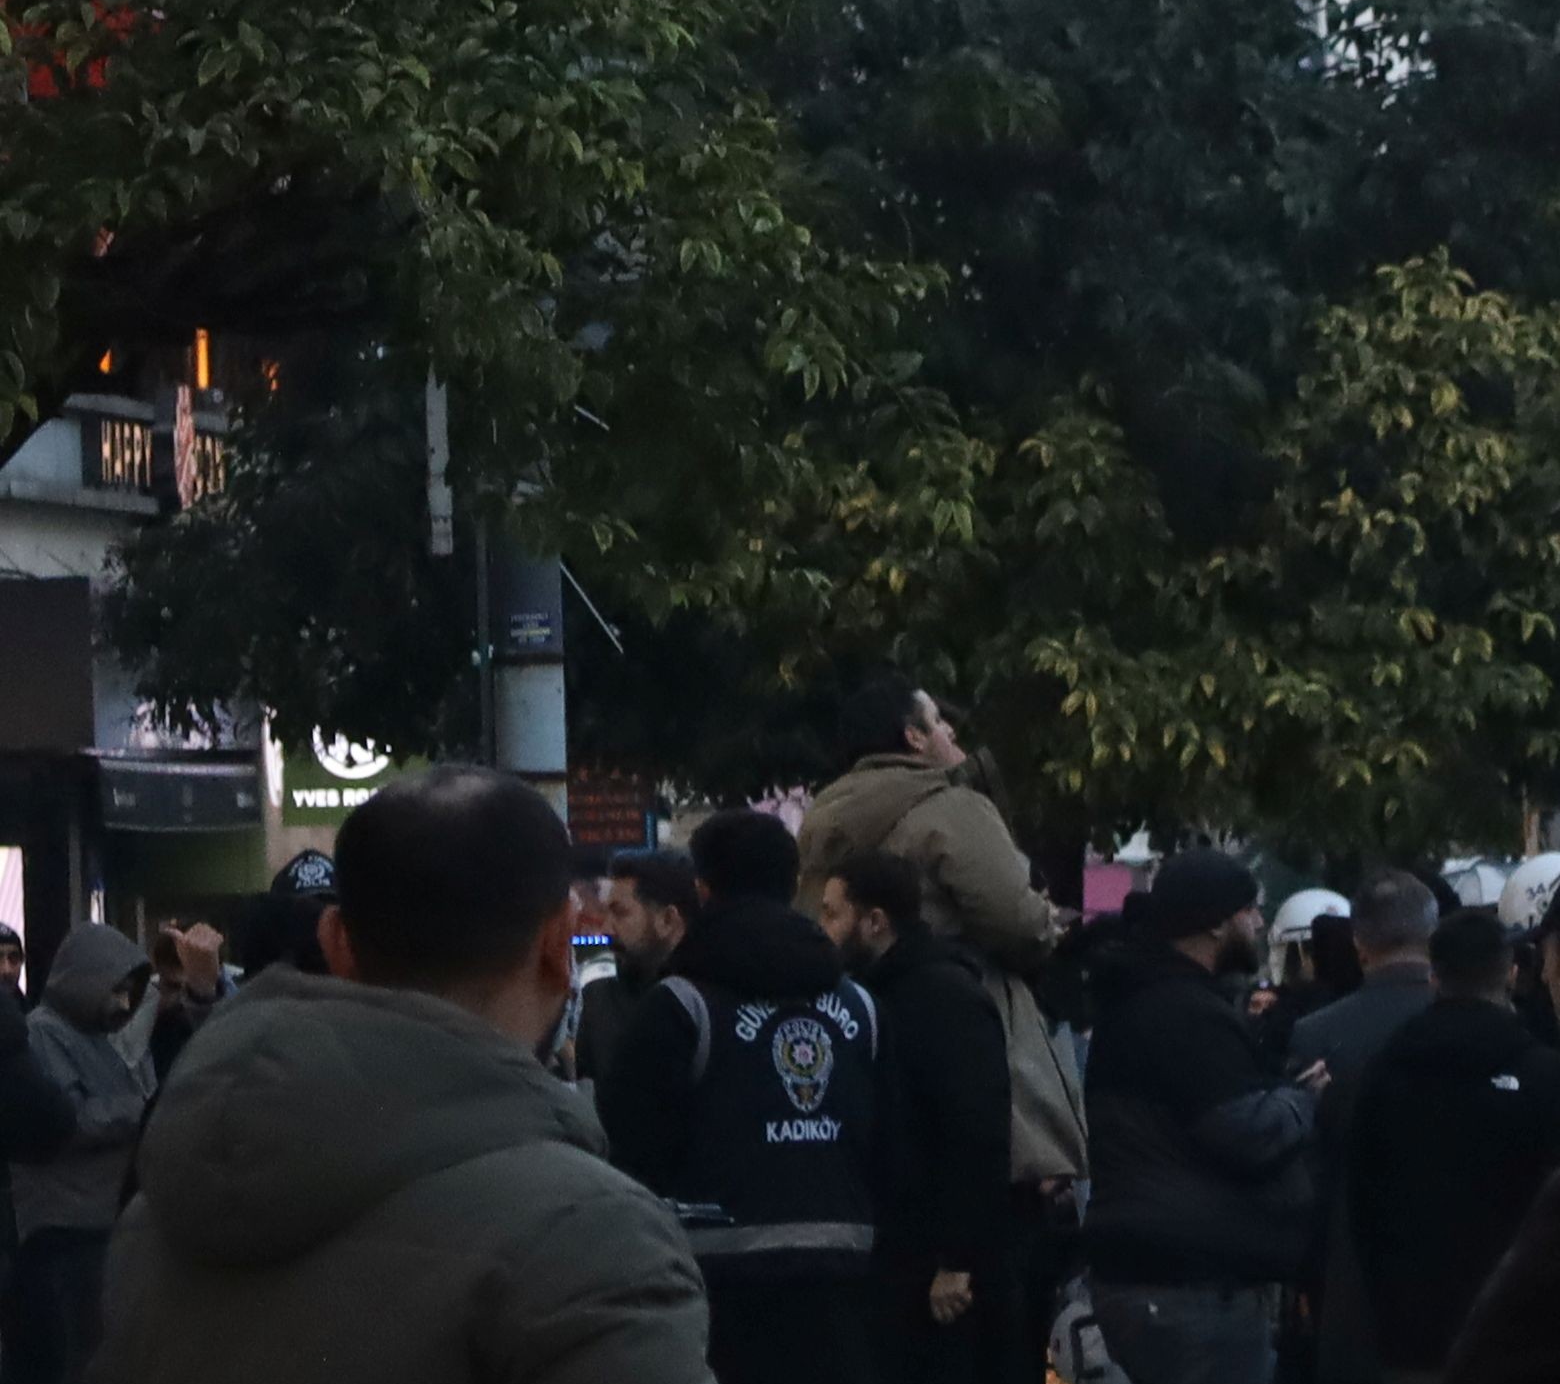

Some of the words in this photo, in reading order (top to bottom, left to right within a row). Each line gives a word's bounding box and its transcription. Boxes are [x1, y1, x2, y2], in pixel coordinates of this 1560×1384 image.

[100, 418, 152, 488] HAPPY
[291, 788, 341, 808] YVES
[342, 788, 379, 808] RO
[766, 1114, 842, 1143] KADIKÖY
